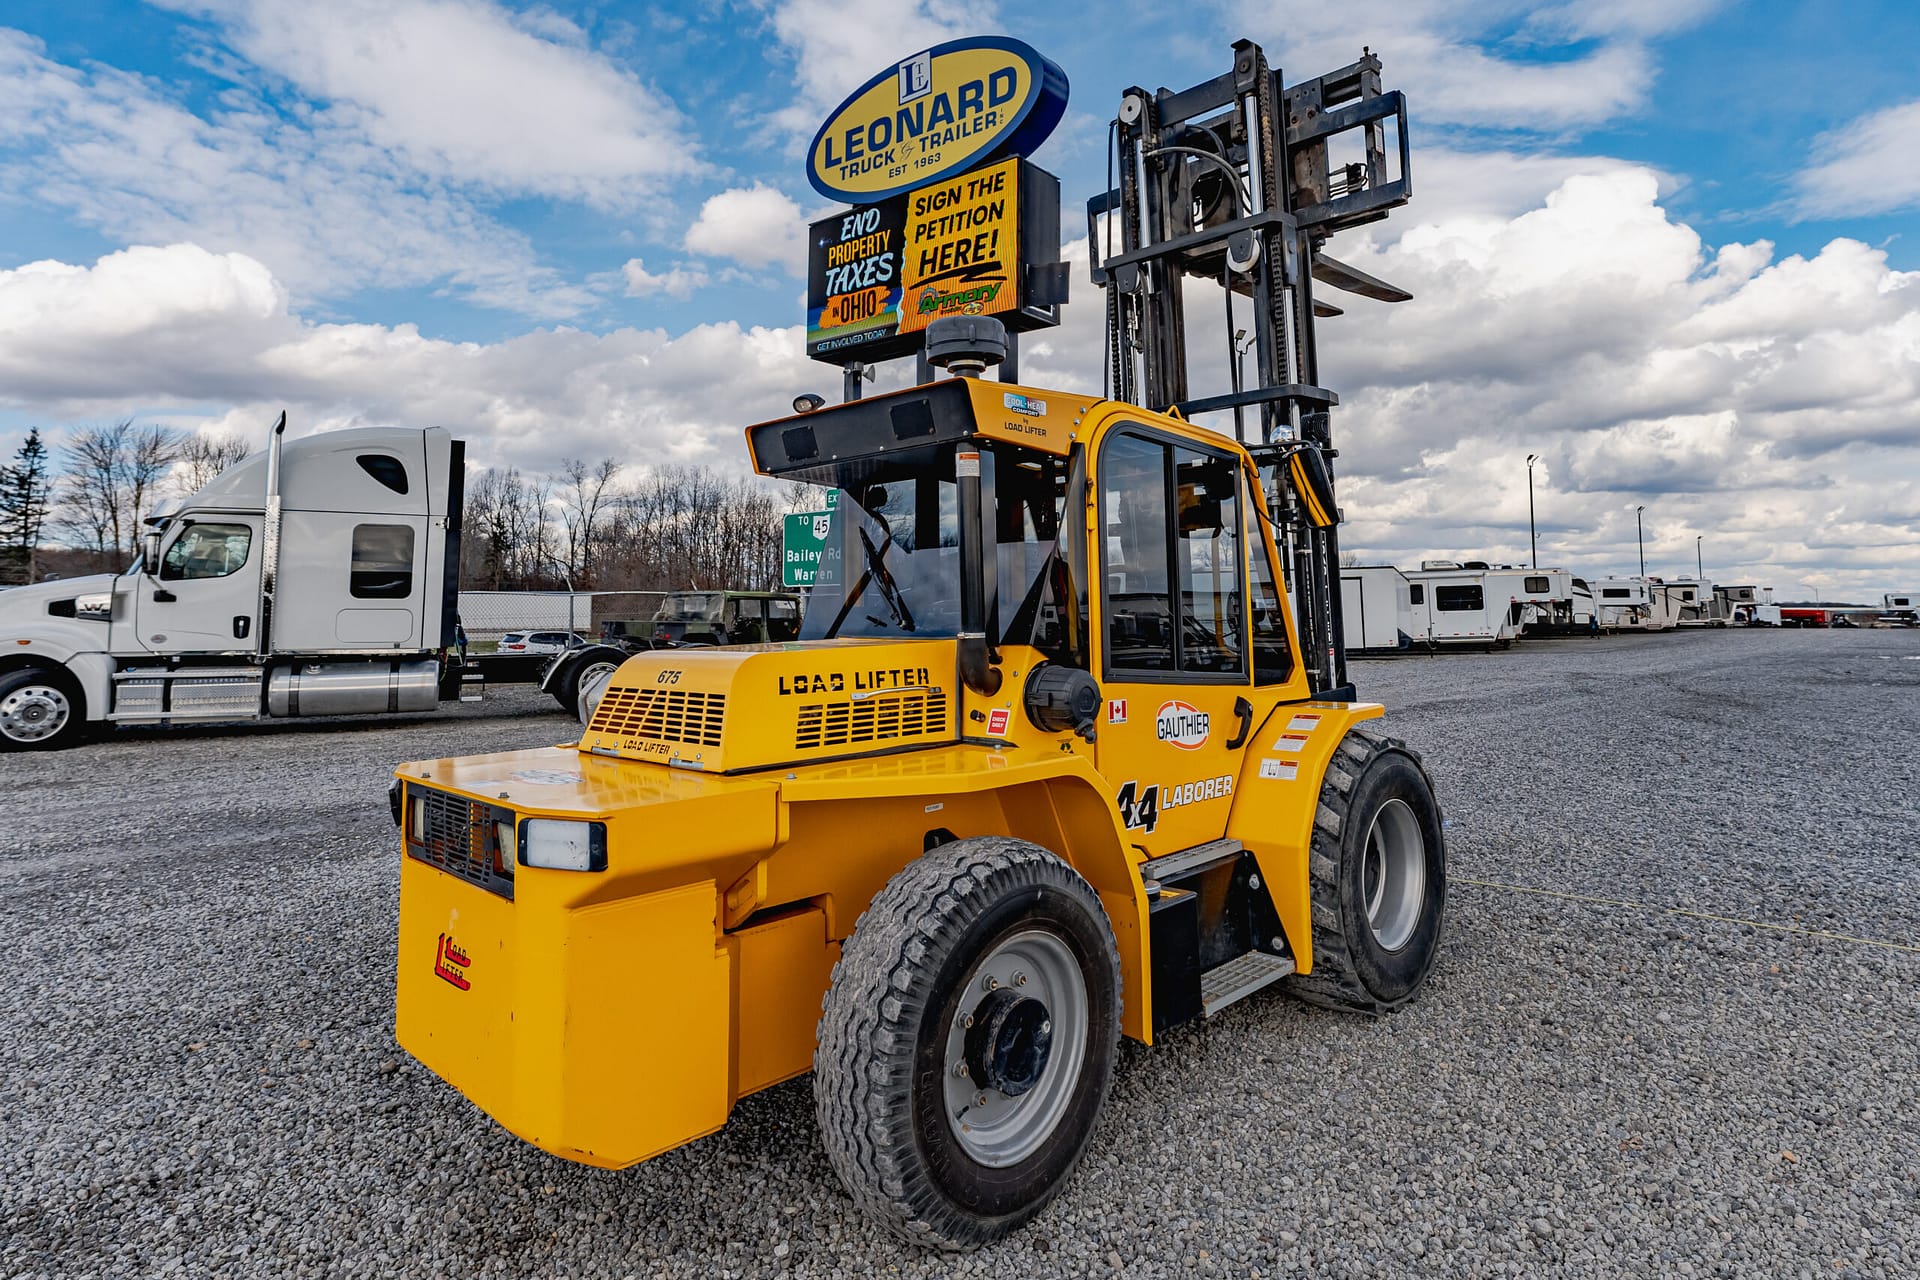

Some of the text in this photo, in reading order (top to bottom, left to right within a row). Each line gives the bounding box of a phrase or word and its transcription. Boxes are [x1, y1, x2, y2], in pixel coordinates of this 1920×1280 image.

[824, 67, 1018, 169] LEONARD
[839, 148, 896, 181] TRUCK
[919, 110, 997, 153] TRAILER
[888, 152, 941, 178] EST 1963
[914, 171, 1007, 217] SIGN THE
[840, 207, 881, 240] END
[914, 199, 1005, 243] PETITION
[828, 229, 891, 268] PROPERTY
[918, 229, 999, 277] HERE!
[825, 252, 894, 297] TAXES
[832, 289, 876, 323] IN OHIO
[917, 282, 1003, 314] Armory
[817, 328, 887, 352] GET INVOLVED TODAY
[1012, 406, 1039, 417] COMFORT
[1004, 421, 1047, 438] LOAD LIFTER
[798, 516, 829, 534] TO 45
[786, 548, 841, 565] Bailey Rd
[657, 670, 682, 684] 675
[778, 667, 930, 696] LOAD LIFTER
[1157, 712, 1210, 740] GAUTHIER
[623, 739, 671, 755] LOAD LIFTER
[1161, 775, 1234, 810] LABORER
